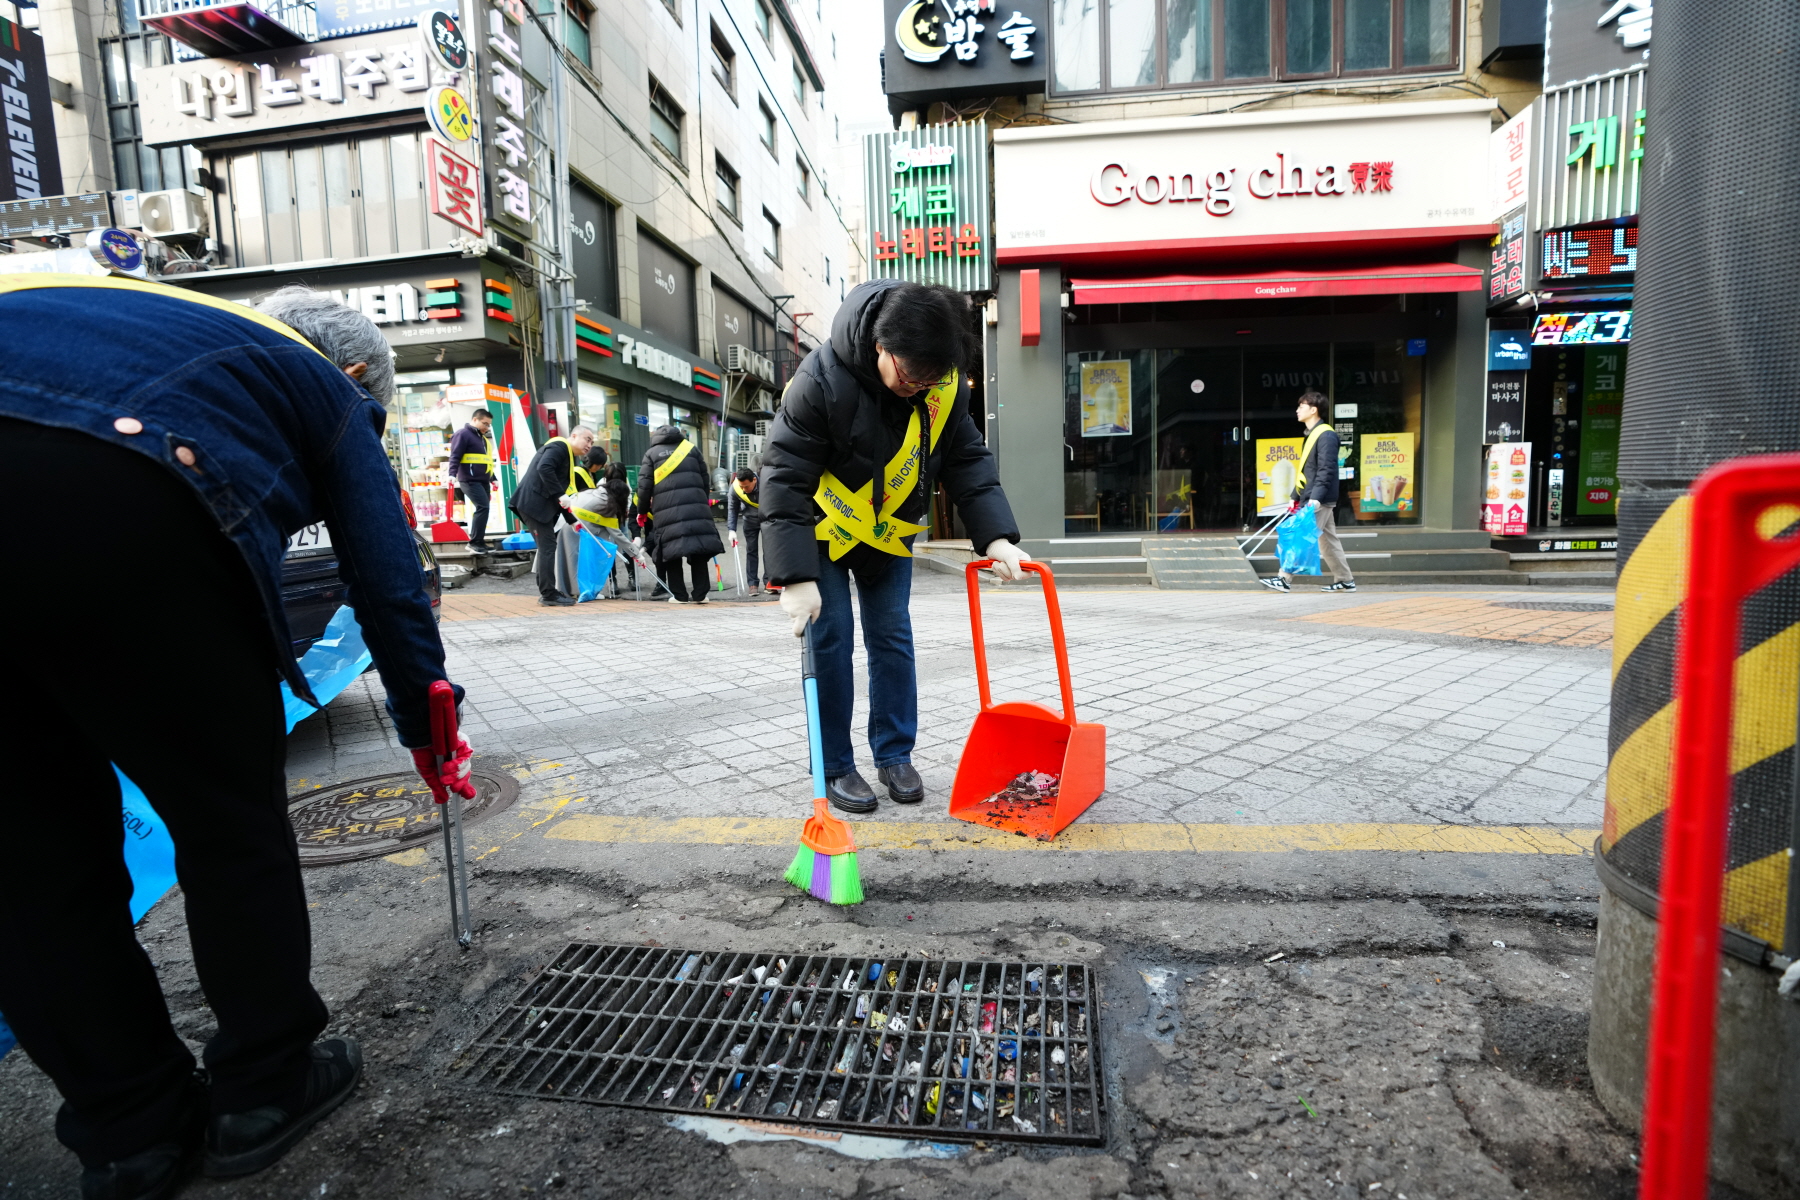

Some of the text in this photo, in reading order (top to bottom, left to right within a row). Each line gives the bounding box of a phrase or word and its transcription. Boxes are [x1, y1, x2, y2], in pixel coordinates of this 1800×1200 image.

[943, 11, 1037, 61] 밤 술
[171, 67, 254, 119] 나인
[259, 41, 431, 108] 노래주점
[488, 8, 531, 222] 노래주점
[1567, 109, 1646, 170] 게
[1089, 158, 1237, 217] Gong
[1247, 147, 1348, 200] cha
[890, 184, 955, 218] 게코
[1426, 208, 1442, 219] 공차
[1009, 228, 1046, 240] 일반음식점
[1502, 213, 1524, 240] 게코
[874, 223, 981, 260] 노래타운
[1491, 236, 1523, 275] 노래
[1255, 286, 1276, 296] Gong
[1490, 266, 1523, 300] 타운
[1089, 376, 1123, 385] SCHOOL
[1093, 368, 1117, 378] BACK
[1491, 392, 1520, 402] 마사지
[1265, 453, 1301, 462] SCHOOL
[1270, 445, 1295, 454] BACK
[1585, 476, 1615, 487] 흡연가능
[1589, 491, 1609, 500] 지하
